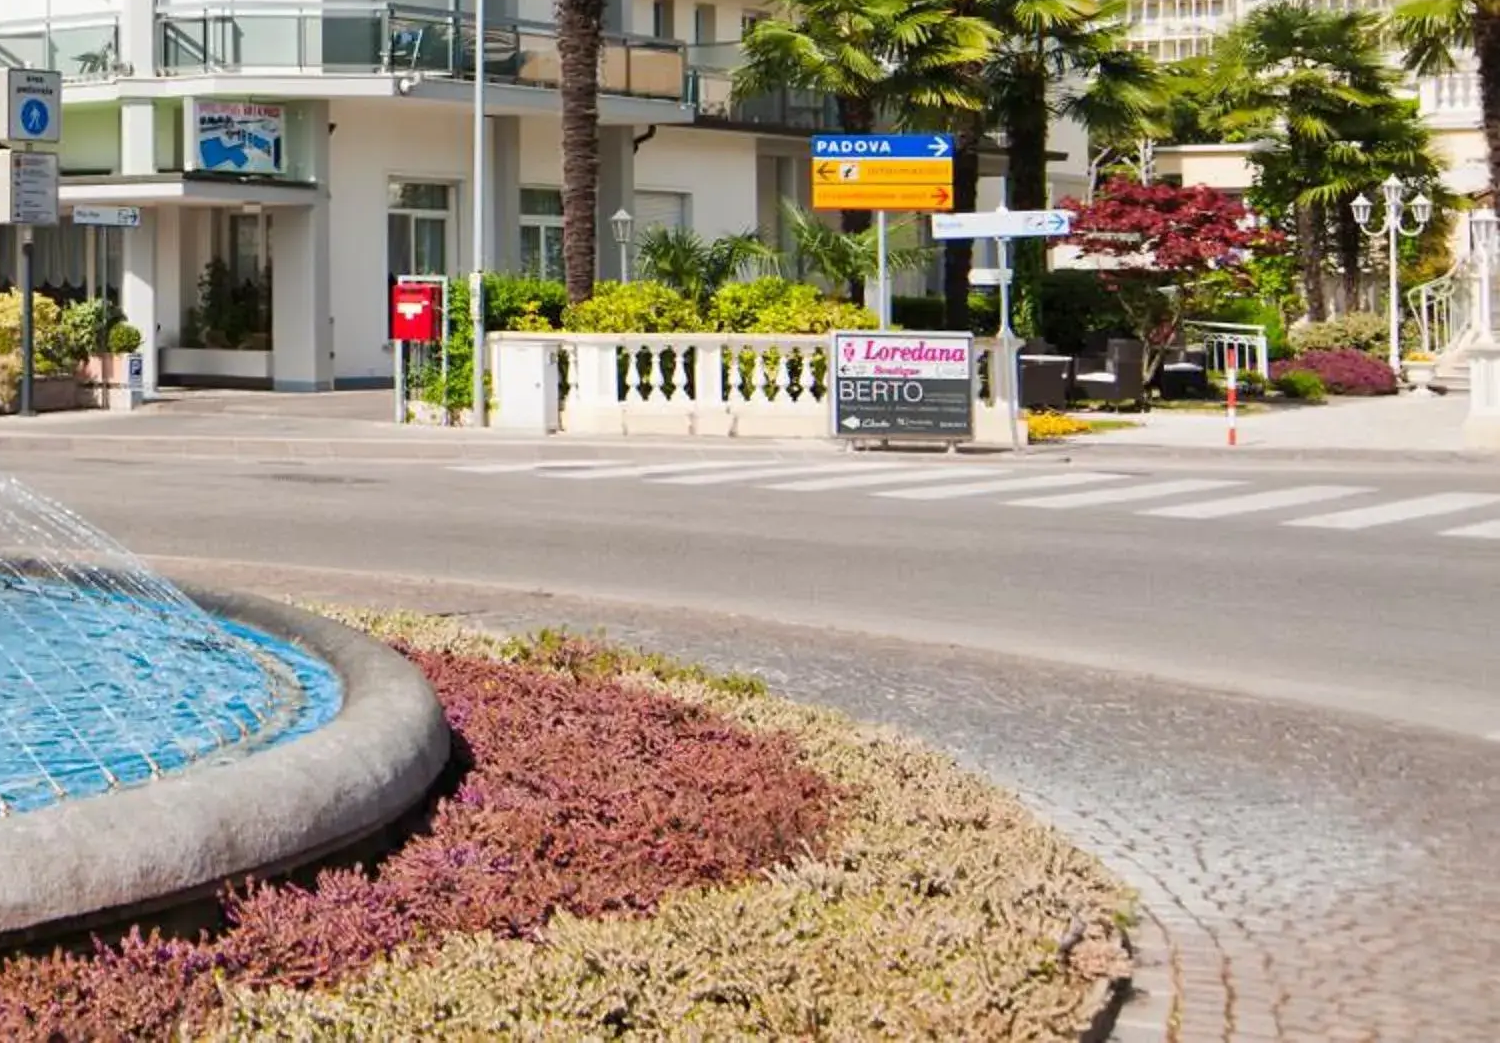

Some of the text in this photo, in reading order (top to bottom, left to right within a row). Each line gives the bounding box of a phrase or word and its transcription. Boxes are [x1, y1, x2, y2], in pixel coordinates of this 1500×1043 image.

[815, 139, 892, 153] PADOVA
[863, 340, 966, 362] Loredana
[838, 380, 924, 403] BERTO
